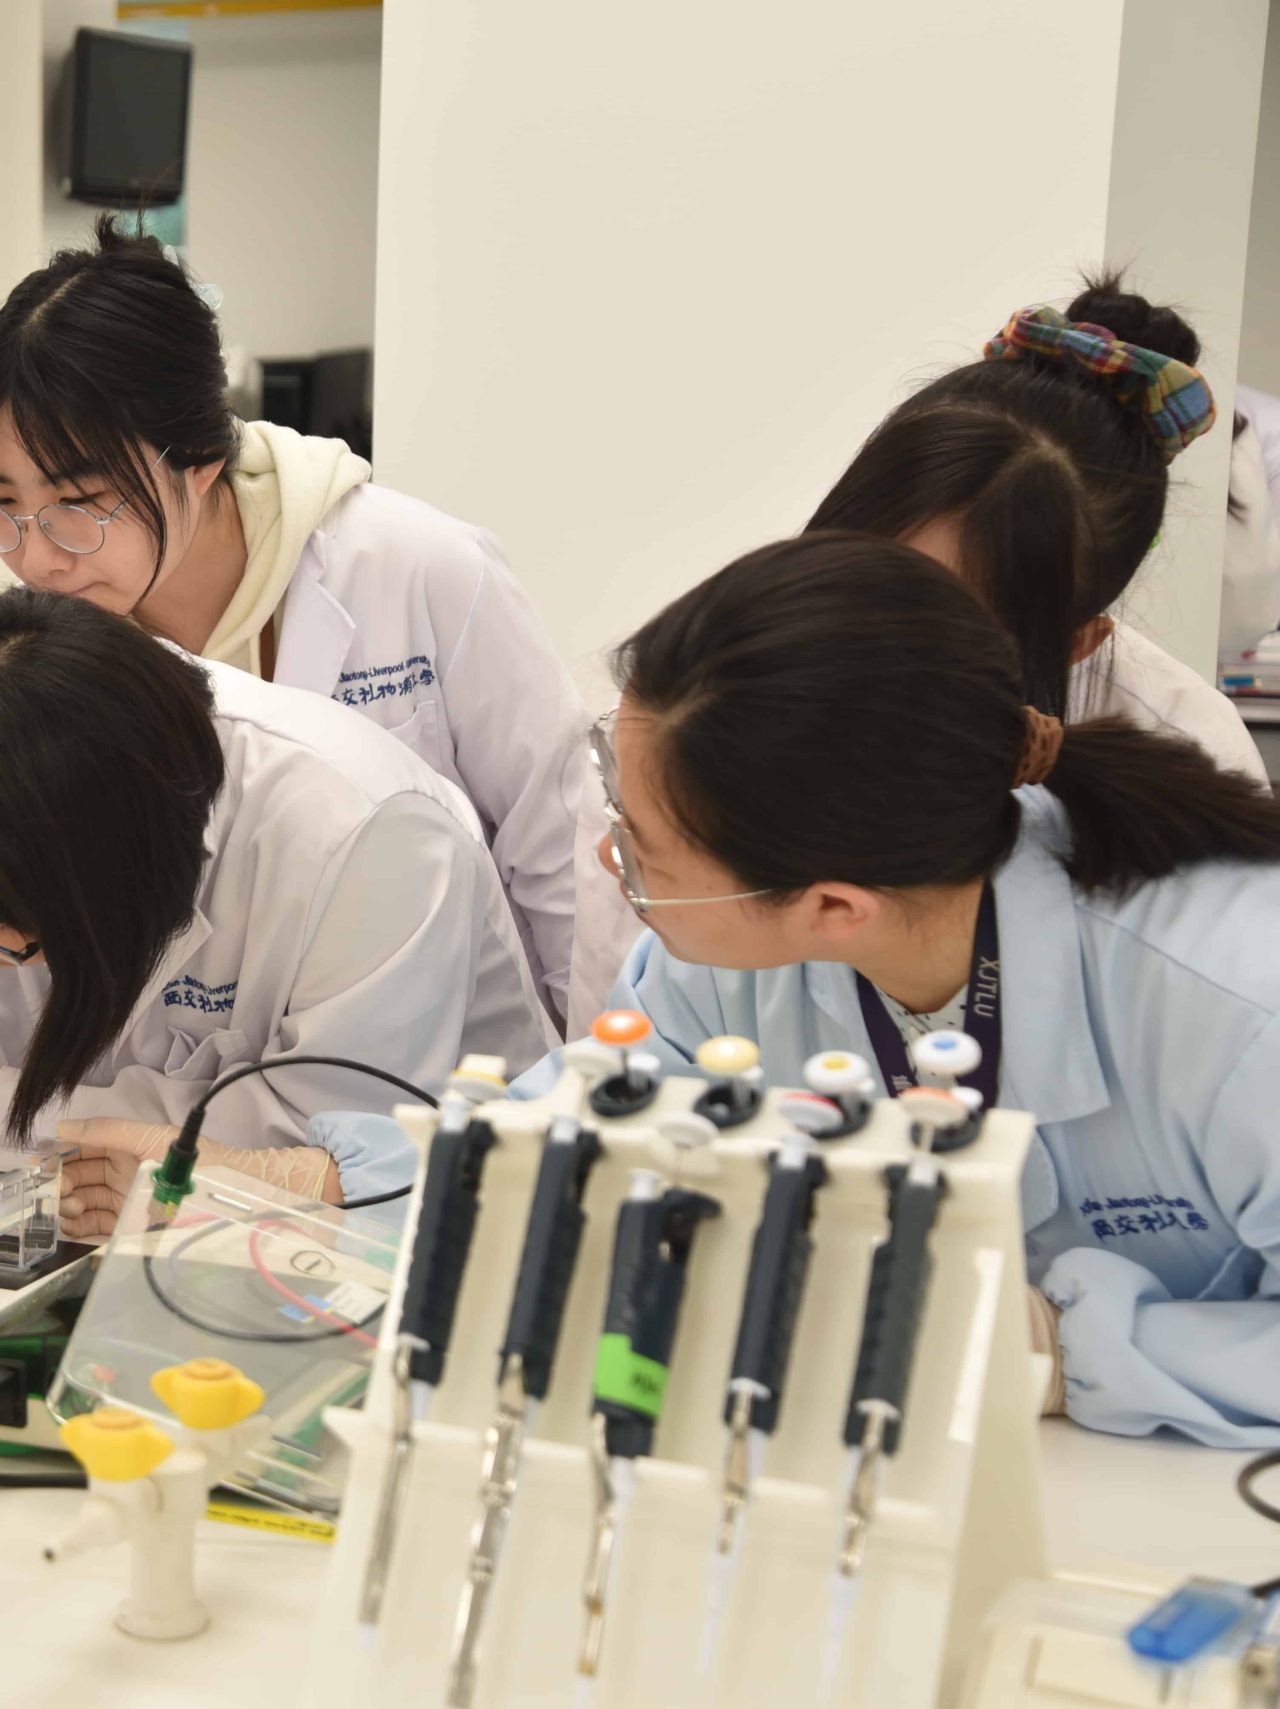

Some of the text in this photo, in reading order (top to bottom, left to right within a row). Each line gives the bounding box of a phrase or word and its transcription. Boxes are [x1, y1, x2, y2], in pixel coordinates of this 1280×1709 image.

[331, 669, 436, 705] 交利物浦学
[973, 956, 1001, 1018] XJTLU
